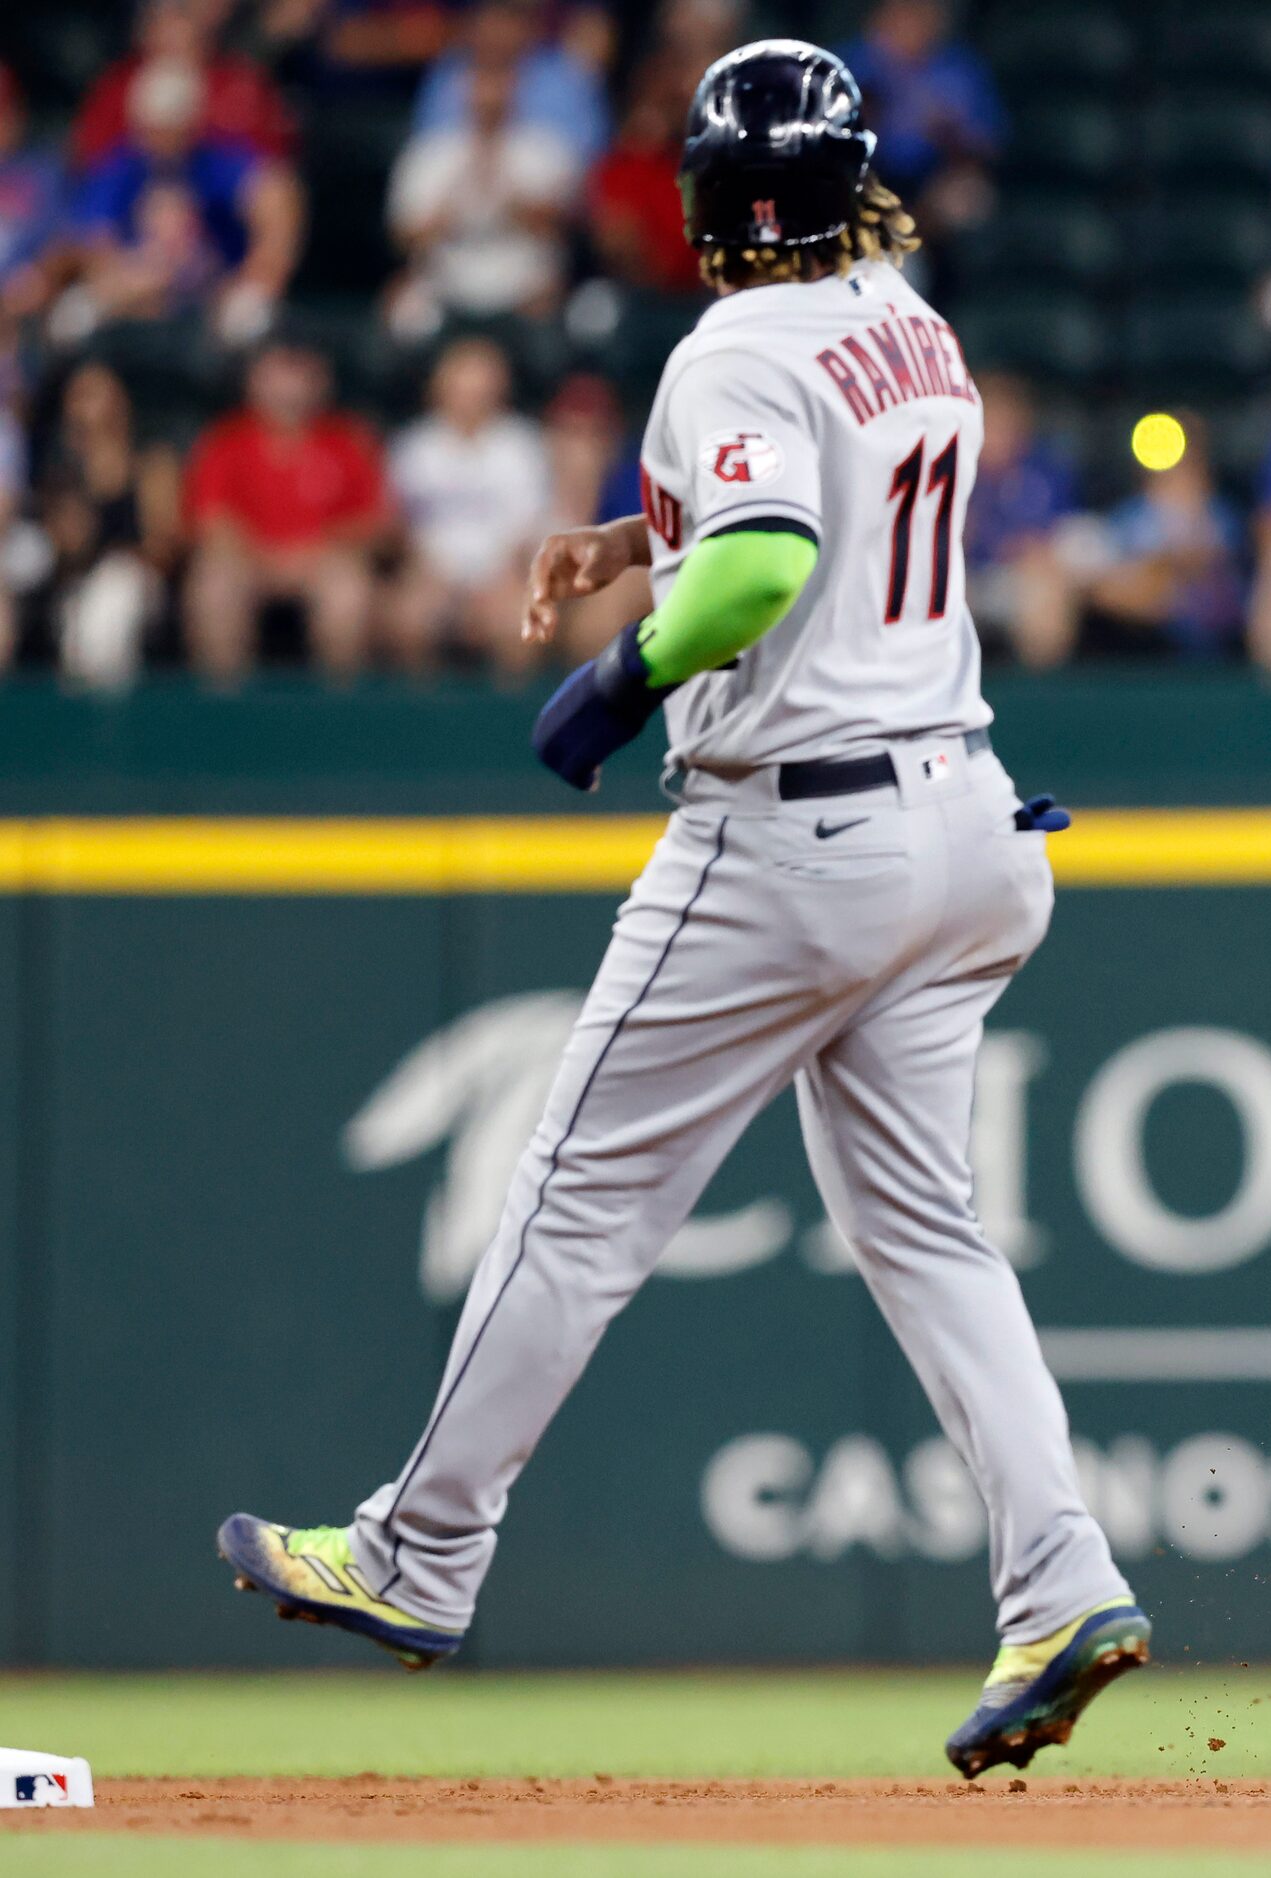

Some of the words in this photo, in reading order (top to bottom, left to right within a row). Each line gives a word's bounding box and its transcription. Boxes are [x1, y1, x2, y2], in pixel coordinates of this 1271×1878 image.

[752, 199, 776, 225] 11
[815, 302, 976, 426] RAMÍRE
[884, 429, 960, 625] 11
